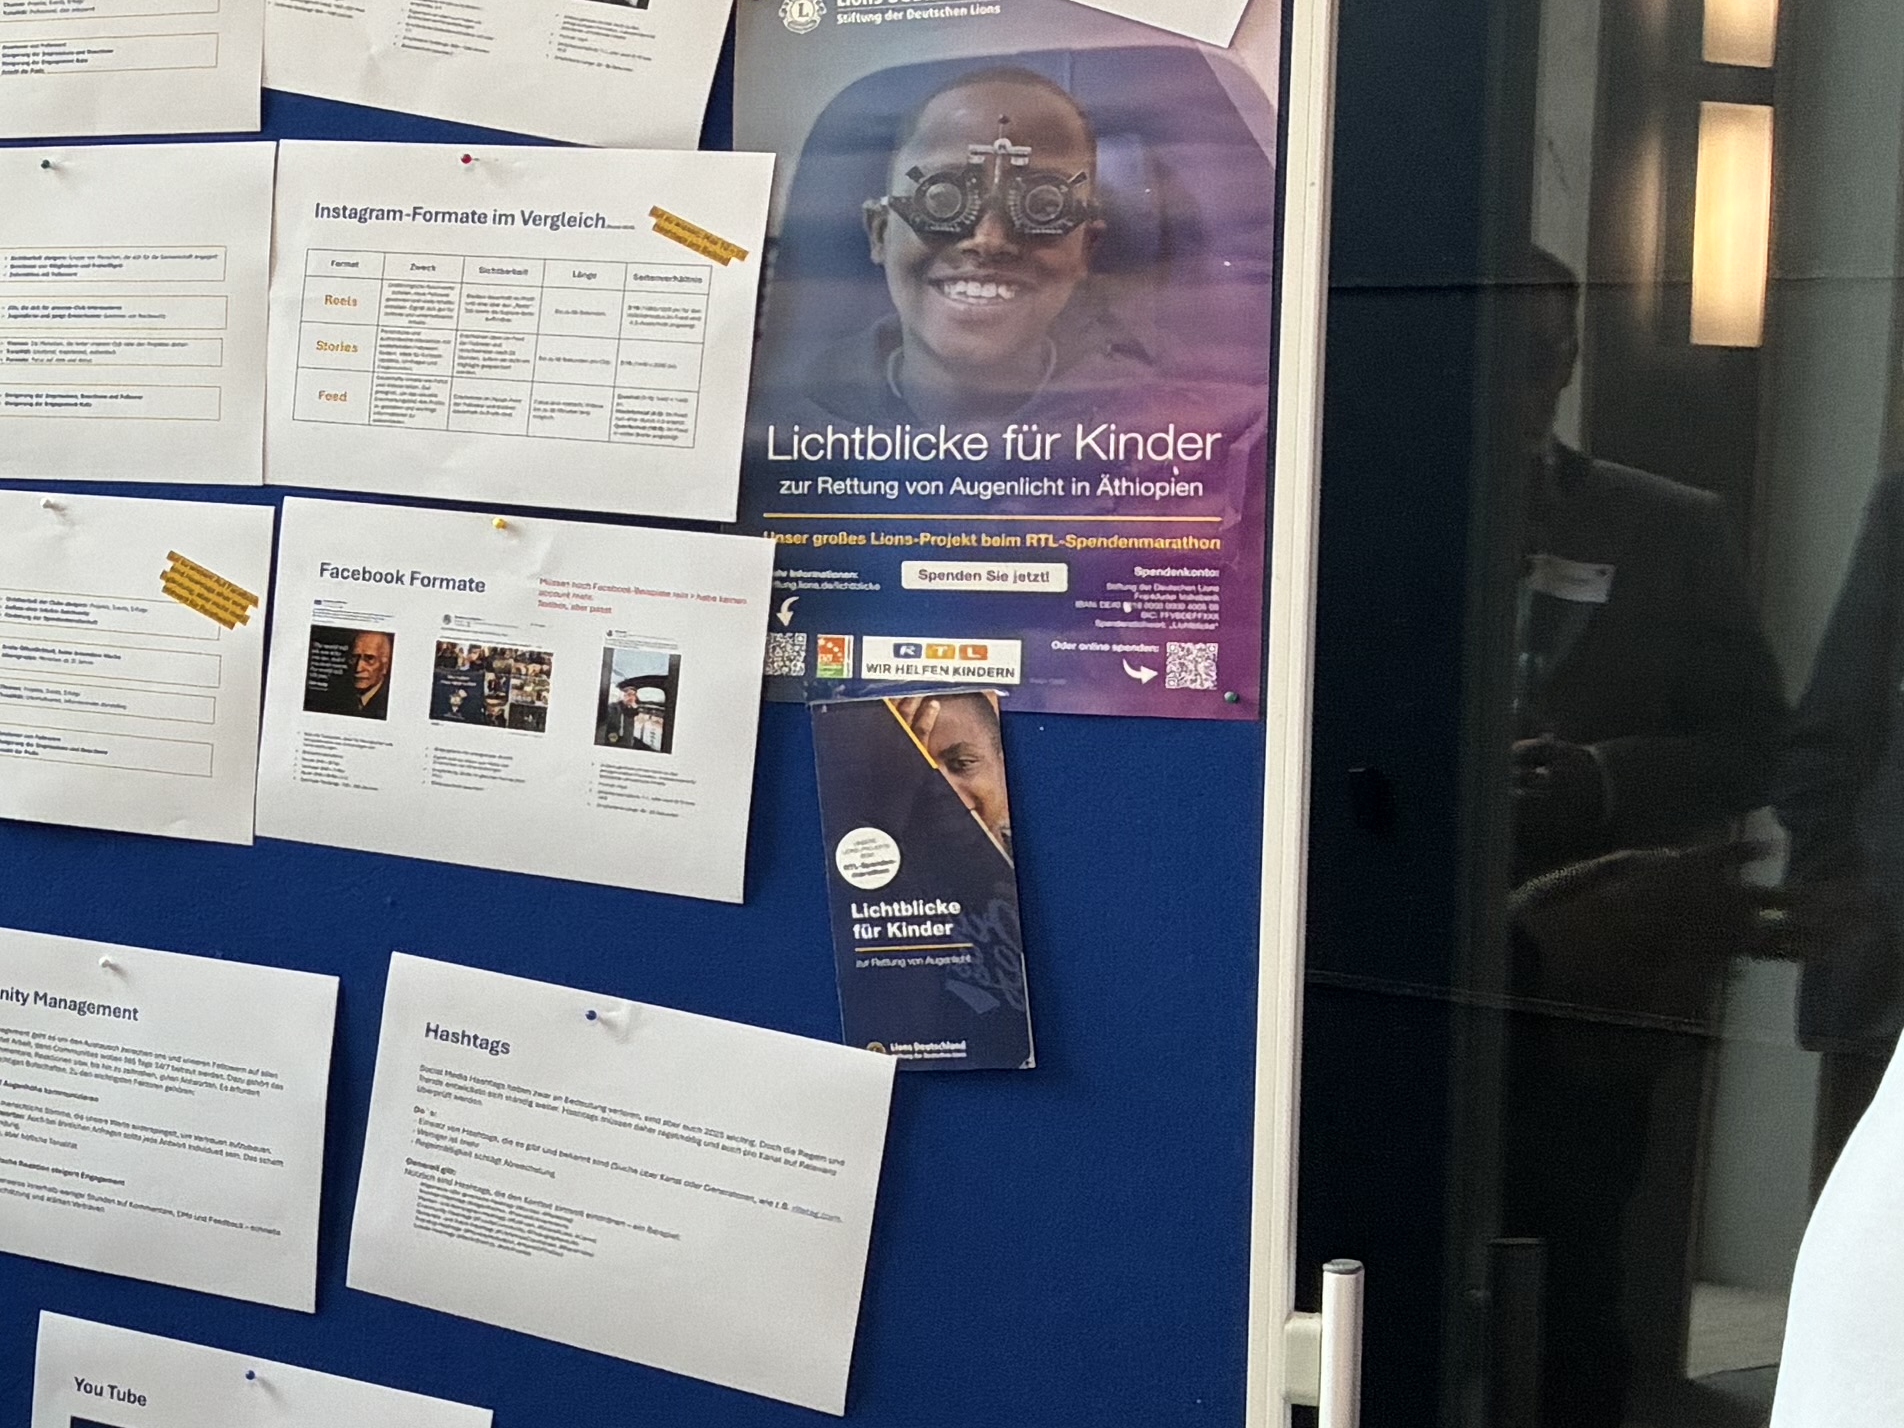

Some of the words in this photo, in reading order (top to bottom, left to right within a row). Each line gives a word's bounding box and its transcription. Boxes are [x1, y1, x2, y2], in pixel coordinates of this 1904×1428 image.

[836, 10, 881, 25] Stiftung
[885, 10, 903, 21] der
[906, 6, 967, 20] Deutschen
[970, 3, 1001, 15] Lions
[314, 202, 488, 226] Instagram-Formate
[492, 210, 515, 226] im
[520, 210, 607, 232] Vergleich
[315, 340, 359, 354] Stories
[317, 390, 348, 403] Feed
[767, 424, 989, 462] Lichtblicke
[1001, 424, 1061, 461] für
[1075, 426, 1222, 462] Kinder
[779, 479, 813, 497] zur
[817, 476, 899, 499] Rettung
[906, 479, 944, 497] von
[949, 475, 1065, 499] Augenlicht
[1071, 477, 1090, 497] in
[1096, 473, 1204, 498] Äthiopien
[813, 532, 866, 548] großes
[871, 533, 978, 548] Lions-Projekt
[981, 533, 1019, 548] beim
[1026, 532, 1220, 551] RTL-Spendenmarathon
[319, 562, 406, 587] Facebook
[409, 571, 486, 594] Formate
[917, 568, 982, 584] Spenden
[985, 568, 1009, 583] Sie
[1012, 567, 1050, 585] jetzt!
[895, 644, 985, 659] RTL
[1051, 641, 1077, 650] Oder
[1079, 642, 1110, 651] online
[1112, 643, 1159, 653] spenden:
[866, 663, 891, 675] WIR
[895, 663, 950, 676] HELFEN
[952, 665, 1015, 679] KINDERN
[851, 899, 961, 919] Lichtblicke
[853, 923, 882, 939] für
[887, 921, 954, 939] Kinder
[33, 990, 139, 1022] Management
[424, 1021, 511, 1057] Hashtags
[74, 1376, 104, 1397] You
[107, 1384, 148, 1407] Tube
